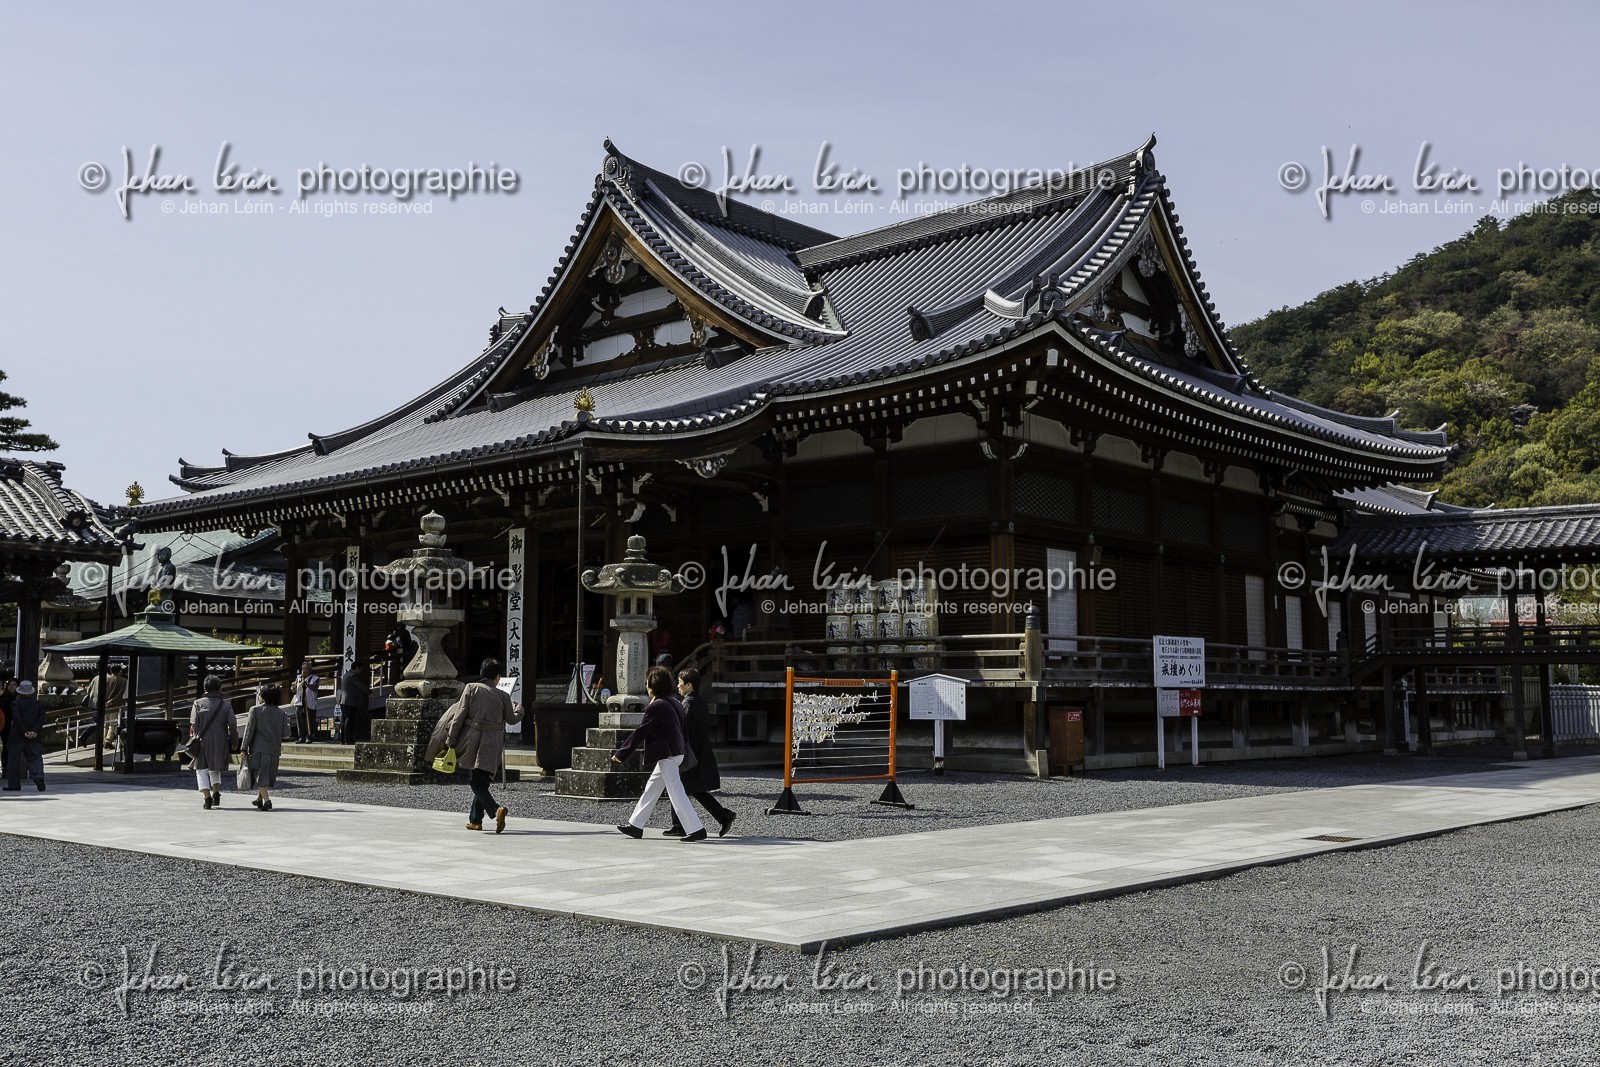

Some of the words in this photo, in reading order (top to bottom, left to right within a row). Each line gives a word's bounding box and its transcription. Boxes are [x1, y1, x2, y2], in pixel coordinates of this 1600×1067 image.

[1162, 663, 1201, 676] 戒壇めぐり
